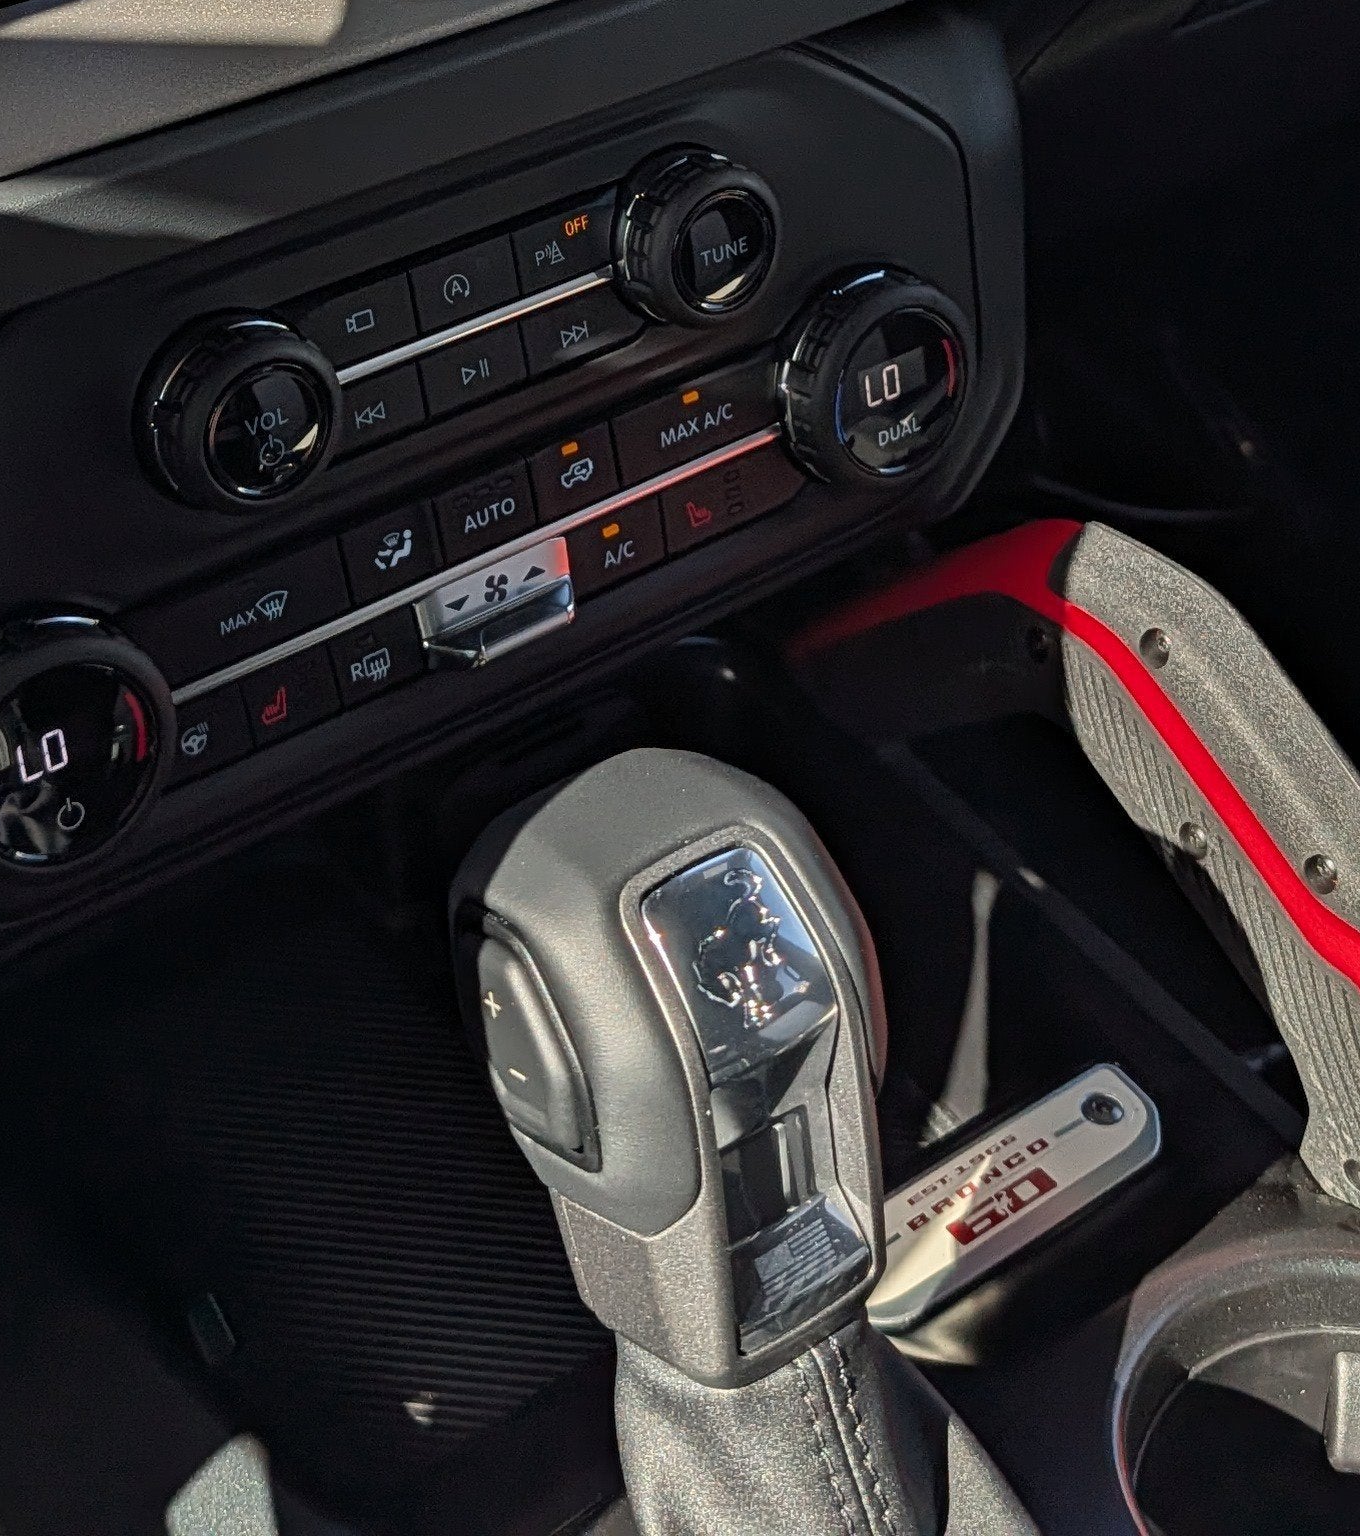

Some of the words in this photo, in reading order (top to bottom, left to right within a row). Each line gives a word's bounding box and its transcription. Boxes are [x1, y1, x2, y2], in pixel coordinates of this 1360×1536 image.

[564, 215, 589, 237] OFF
[700, 237, 749, 266] TUNE
[244, 408, 290, 436] VOL
[660, 417, 699, 447] MAX
[703, 404, 734, 431] A/C
[877, 417, 921, 447] DUAL
[464, 497, 516, 533] AUTO
[604, 539, 635, 568] A/C
[219, 609, 258, 636] MAX
[907, 1138, 1049, 1231] BRONCO
